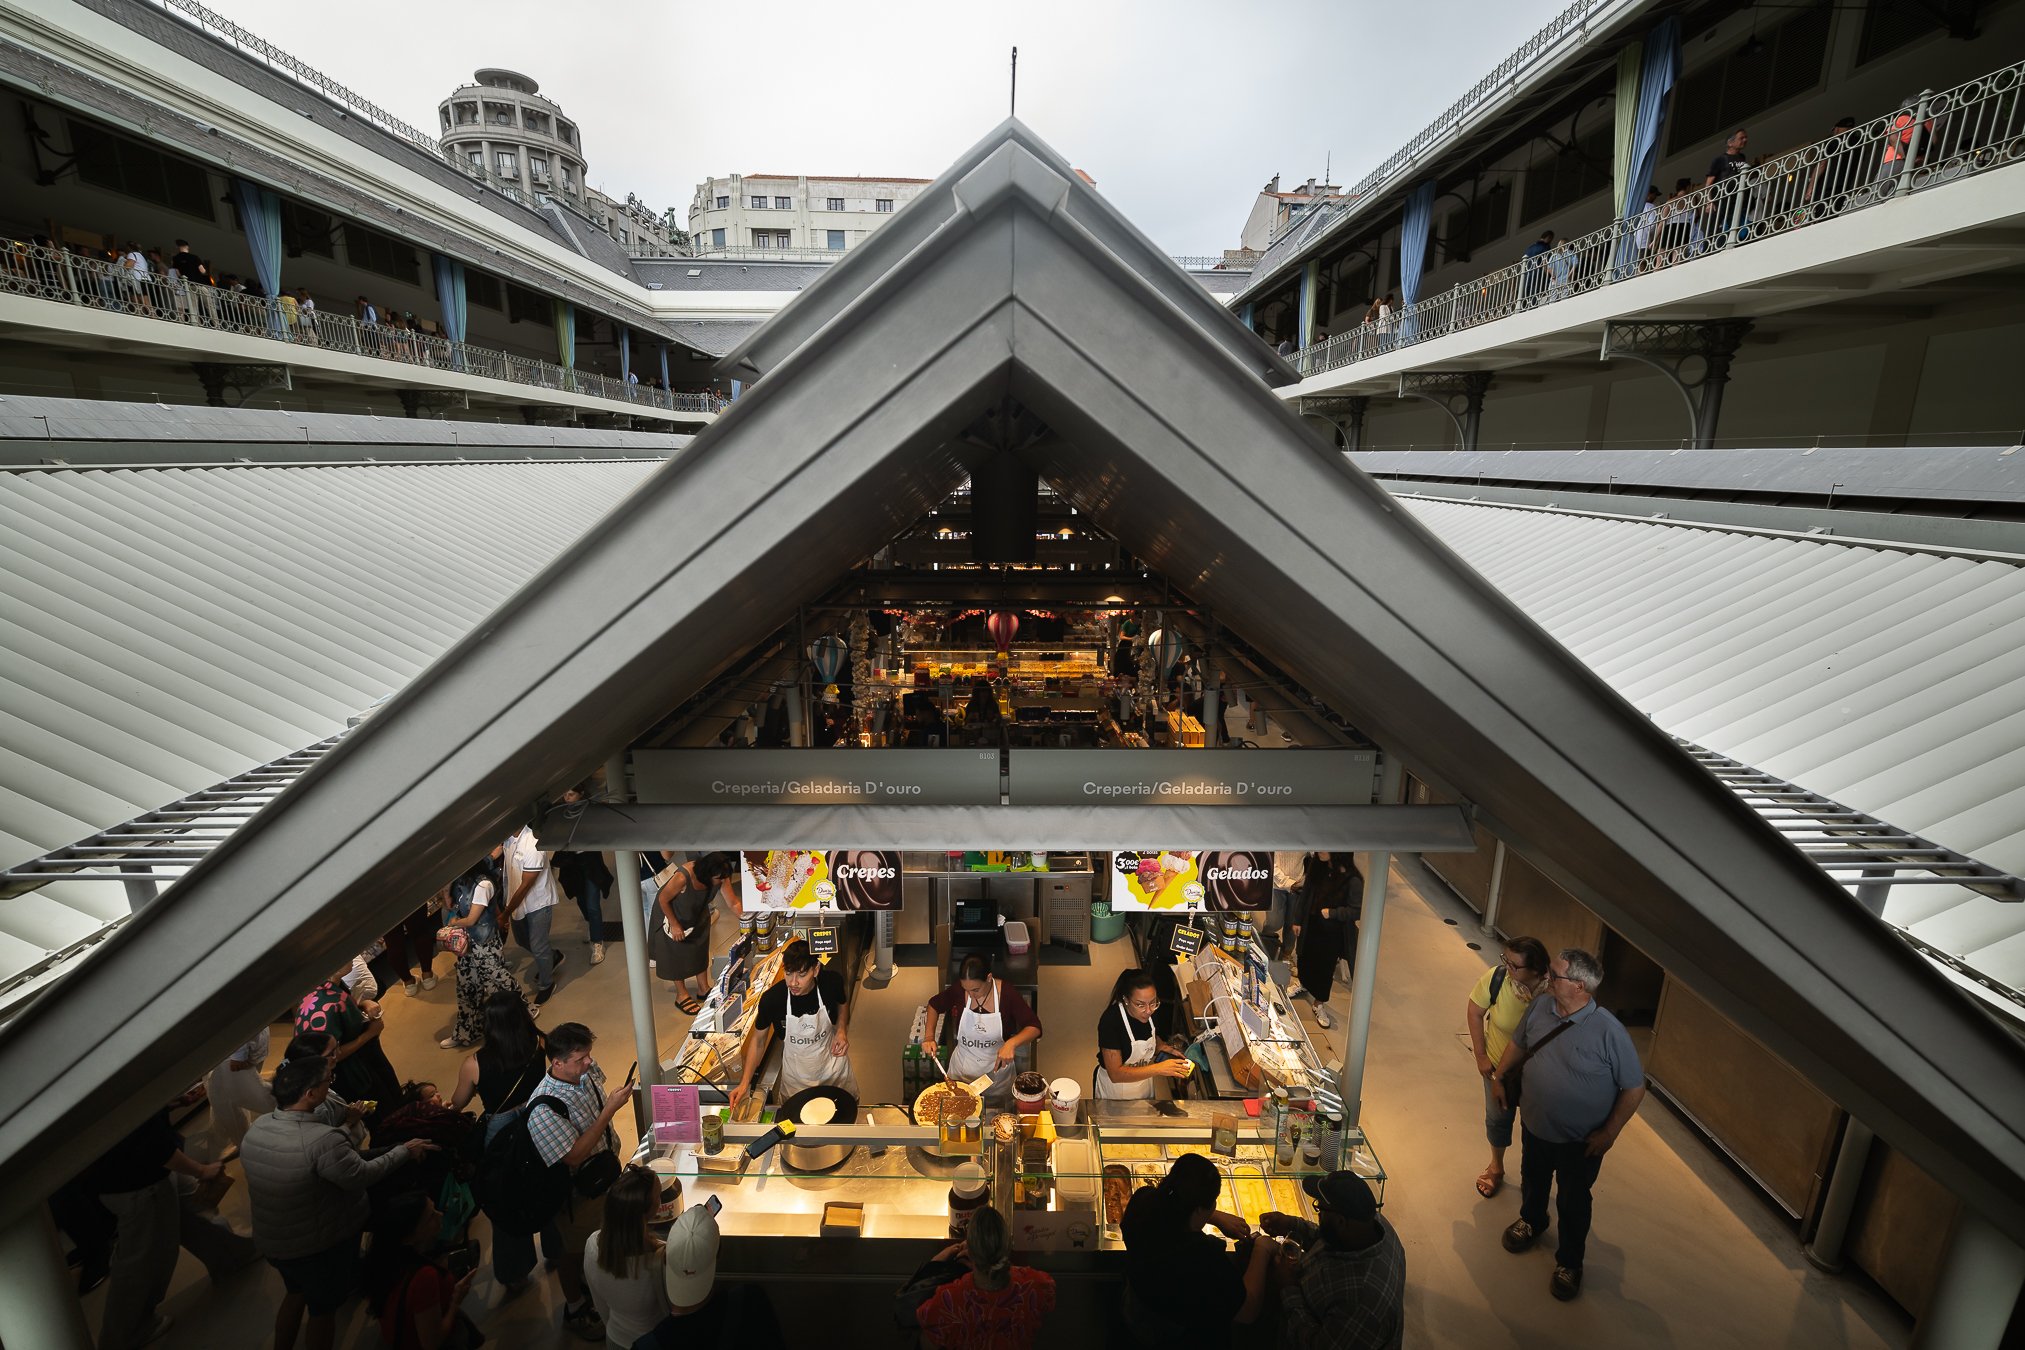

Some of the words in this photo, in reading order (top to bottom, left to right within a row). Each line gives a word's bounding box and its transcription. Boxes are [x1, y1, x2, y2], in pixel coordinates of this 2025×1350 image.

[711, 781, 861, 796] Creperia/Geladaria
[1083, 781, 1232, 797] Creperia/Geladaria
[837, 865, 896, 882] Crepes
[1207, 866, 1269, 880] Gelados
[790, 1030, 827, 1045] Bolhão
[961, 1036, 998, 1048] Bolhão
